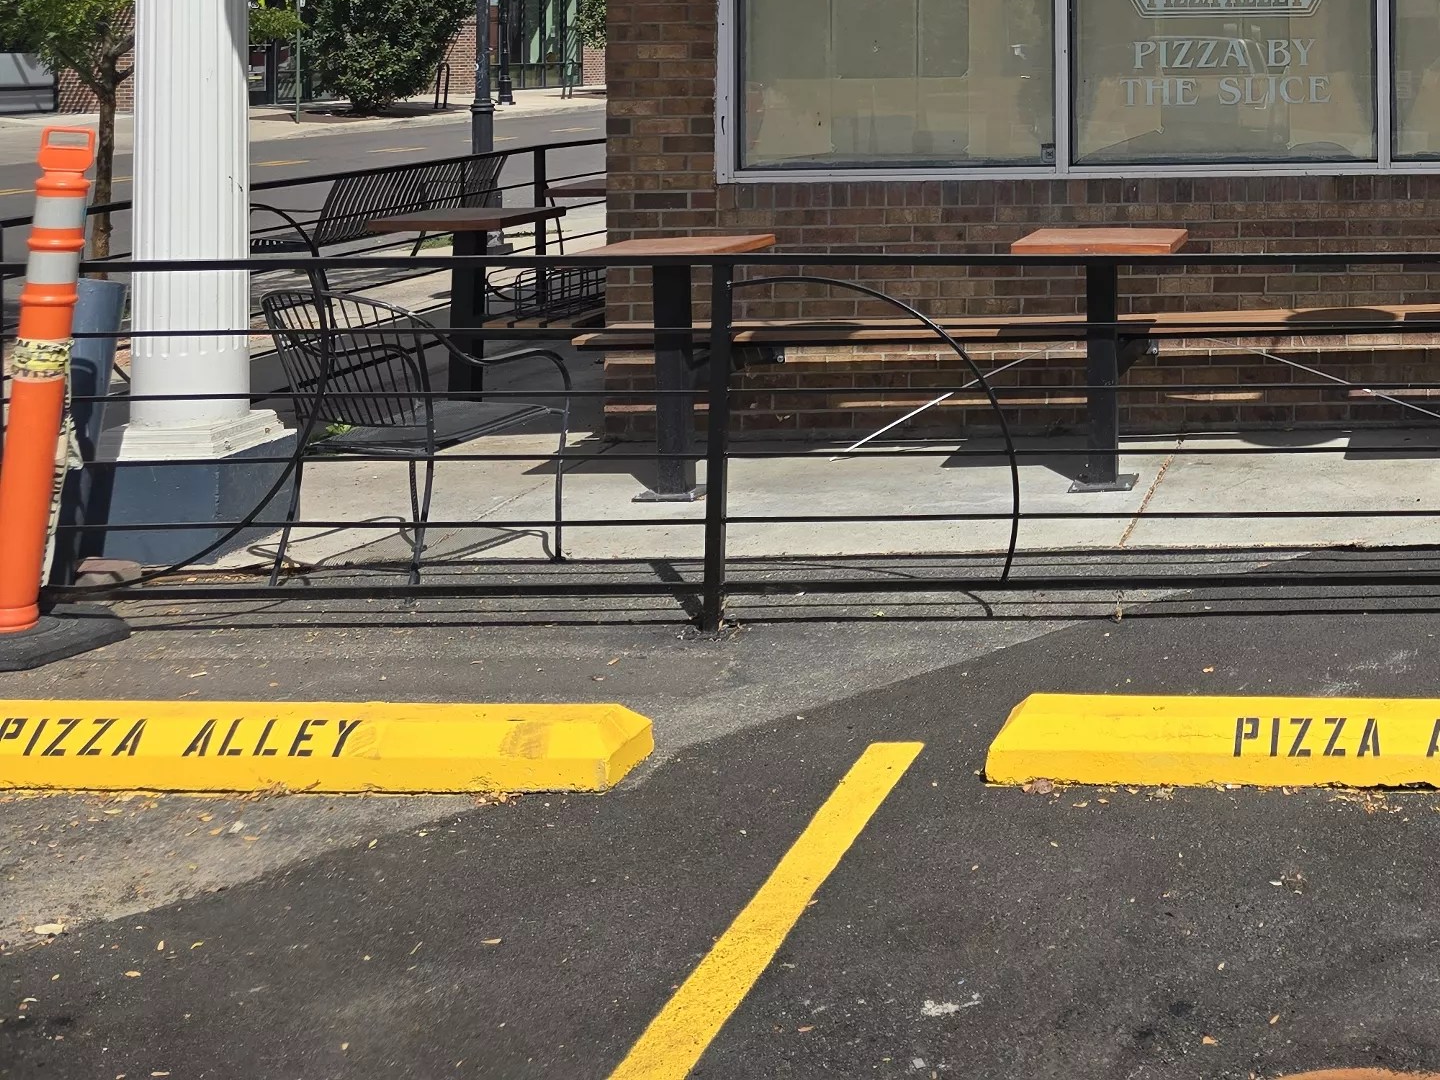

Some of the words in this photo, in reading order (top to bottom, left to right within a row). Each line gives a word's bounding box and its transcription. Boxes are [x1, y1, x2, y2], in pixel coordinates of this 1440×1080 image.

[1132, 39, 1249, 69] PIZZA
[1266, 38, 1317, 67] BY
[1120, 77, 1199, 106] THE
[1218, 75, 1332, 105] SLICE
[0, 718, 149, 756] PIZZA
[181, 718, 363, 758] ALLEY
[1233, 717, 1380, 757] PIZZA
